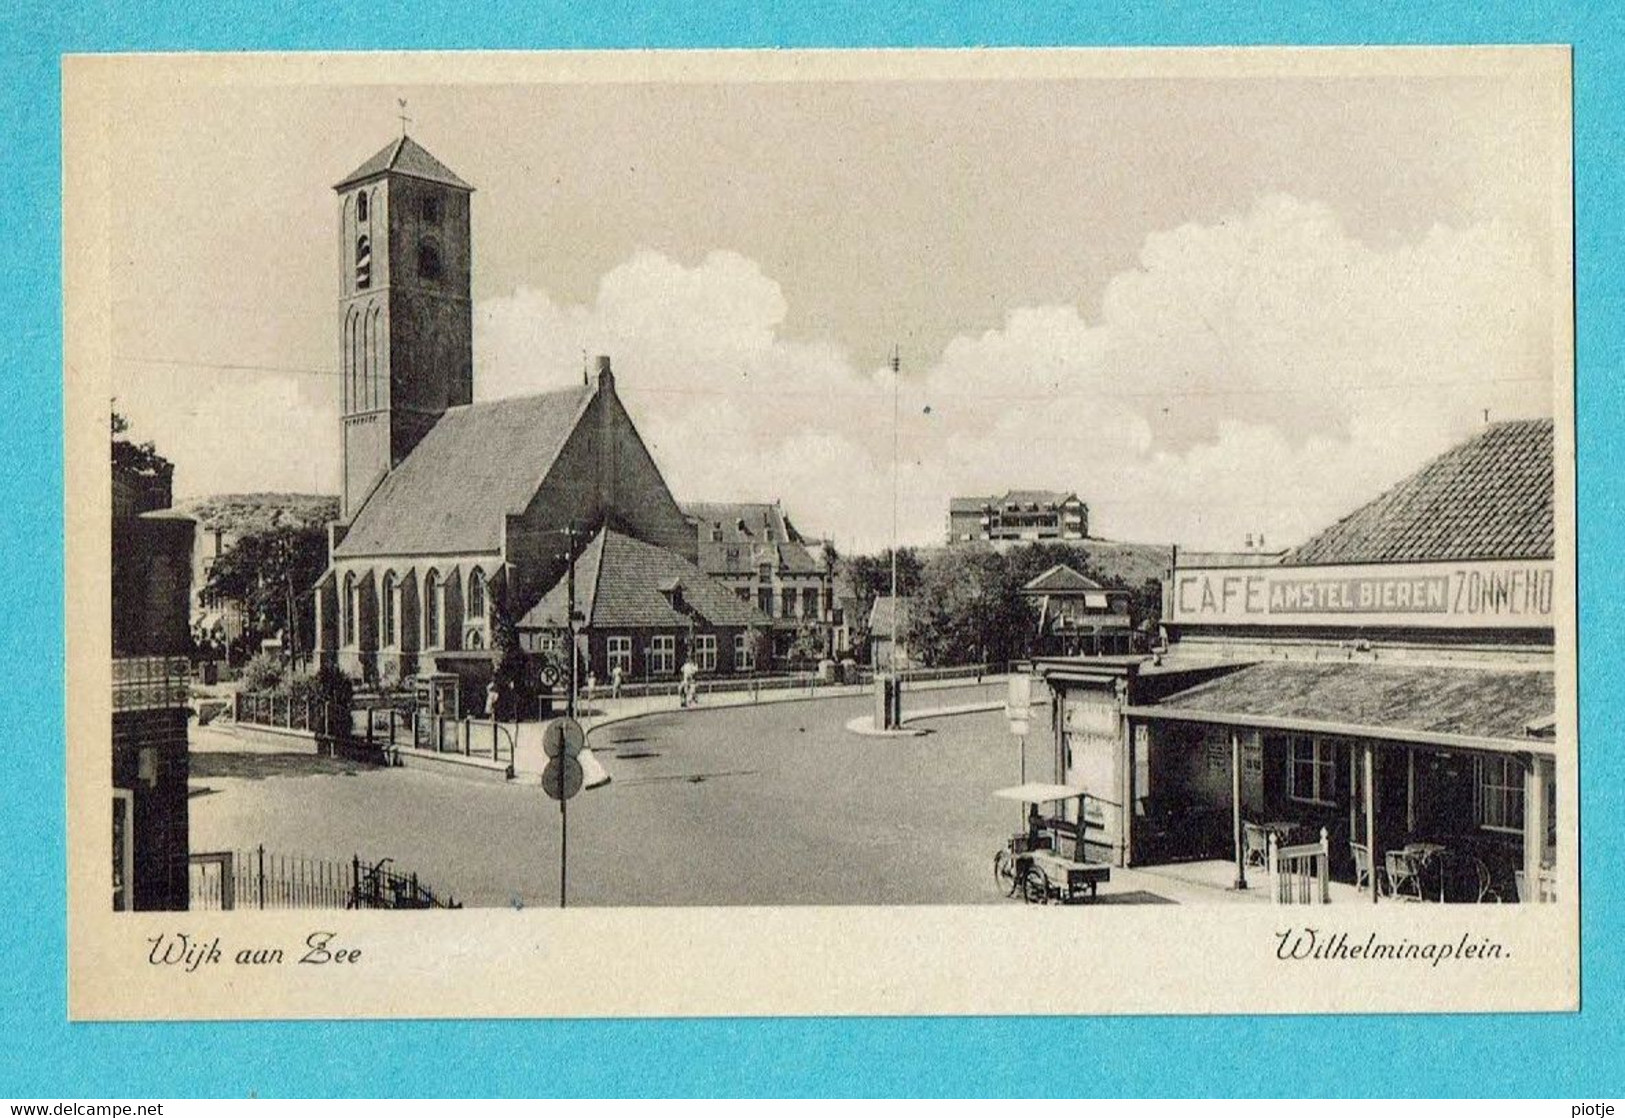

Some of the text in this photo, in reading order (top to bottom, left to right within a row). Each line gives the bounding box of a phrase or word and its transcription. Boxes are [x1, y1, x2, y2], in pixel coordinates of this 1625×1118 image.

[1271, 581, 1354, 609] AMSTEL
[1358, 577, 1442, 609] BIEREN
[148, 931, 362, 973] Wijk aan Zee
[1275, 927, 1511, 967] Wilhelminaplein.
